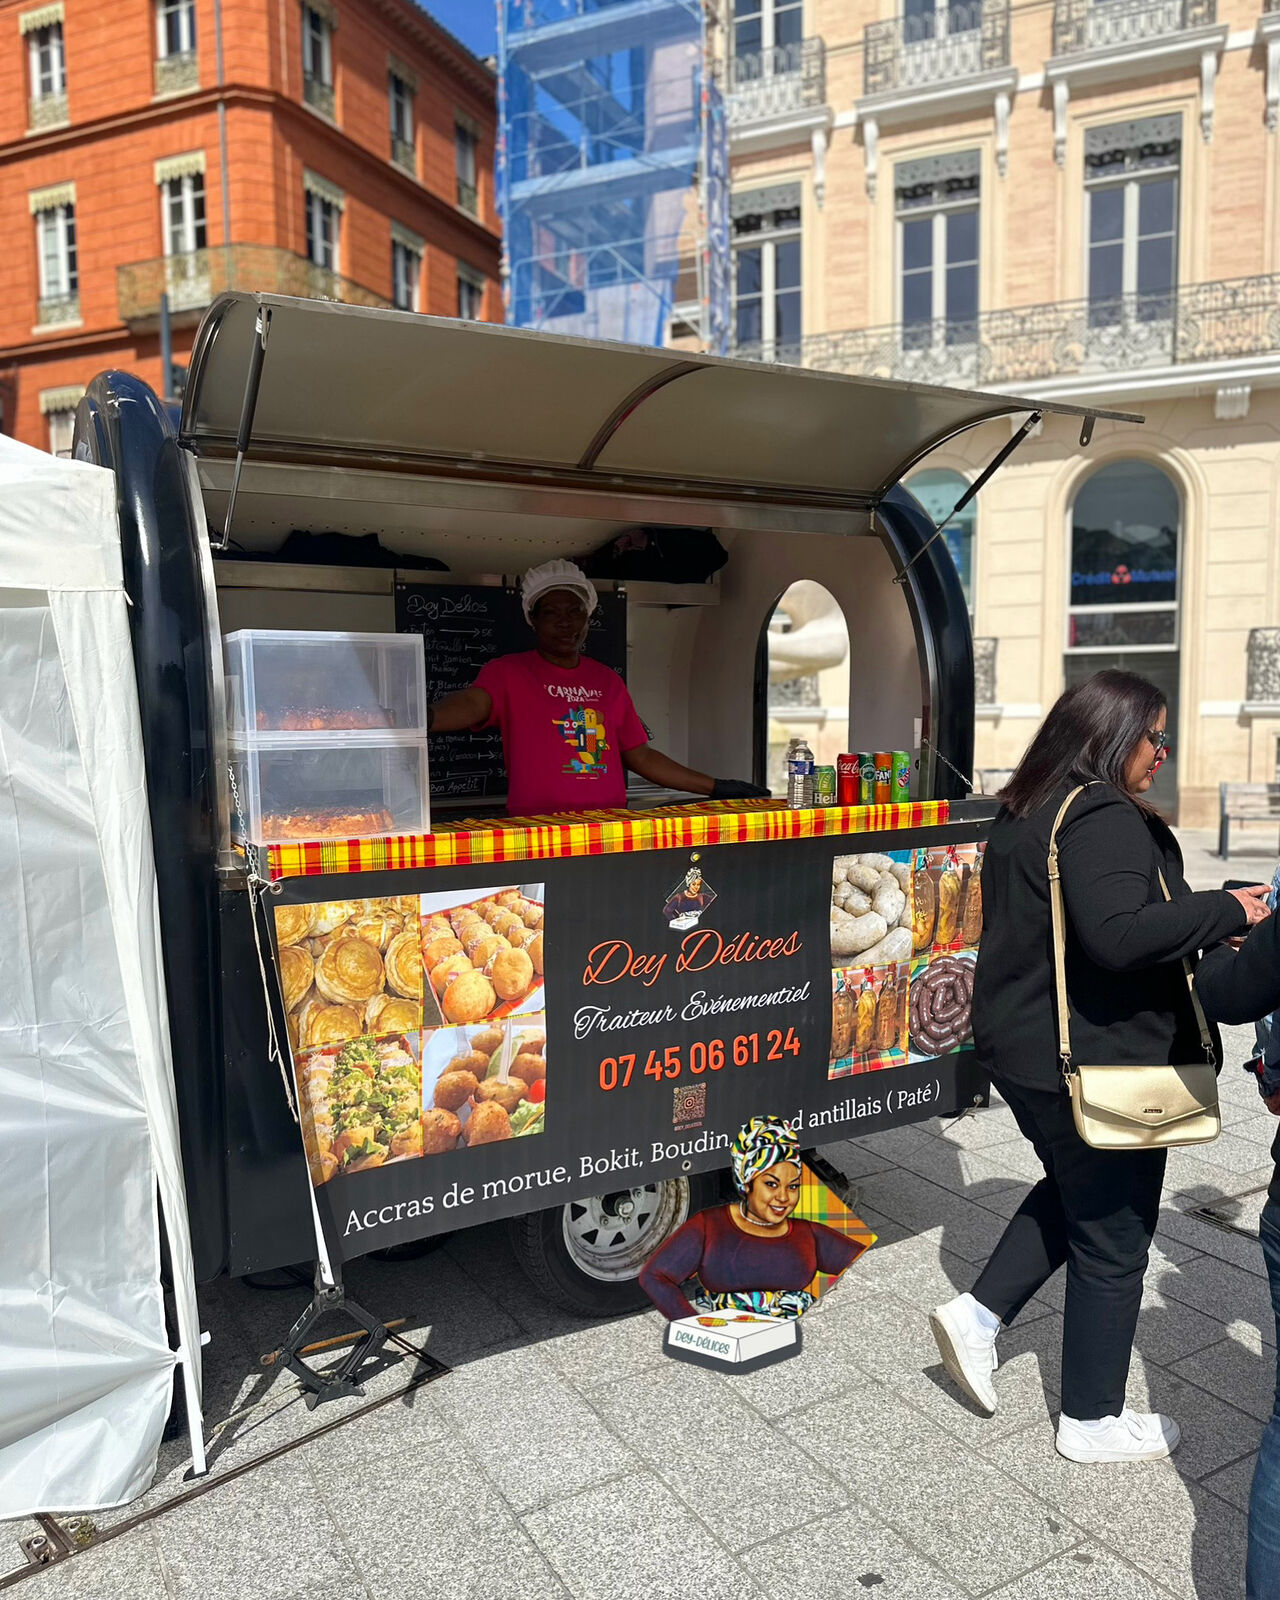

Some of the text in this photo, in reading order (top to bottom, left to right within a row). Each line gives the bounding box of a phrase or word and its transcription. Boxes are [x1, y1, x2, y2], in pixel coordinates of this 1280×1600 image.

[583, 929, 802, 986] Dey Délices
[573, 981, 811, 1040] Traiteur Evénementiel
[599, 1027, 801, 1091] 07 45 06 61 24
[343, 1199, 434, 1237] Accras
[442, 1184, 475, 1209] de
[482, 1166, 572, 1201] morue,
[579, 1147, 645, 1179] Bokit,
[650, 1130, 735, 1164] Boudin,
[808, 1096, 882, 1128] antillais
[897, 1083, 932, 1110] Paté
